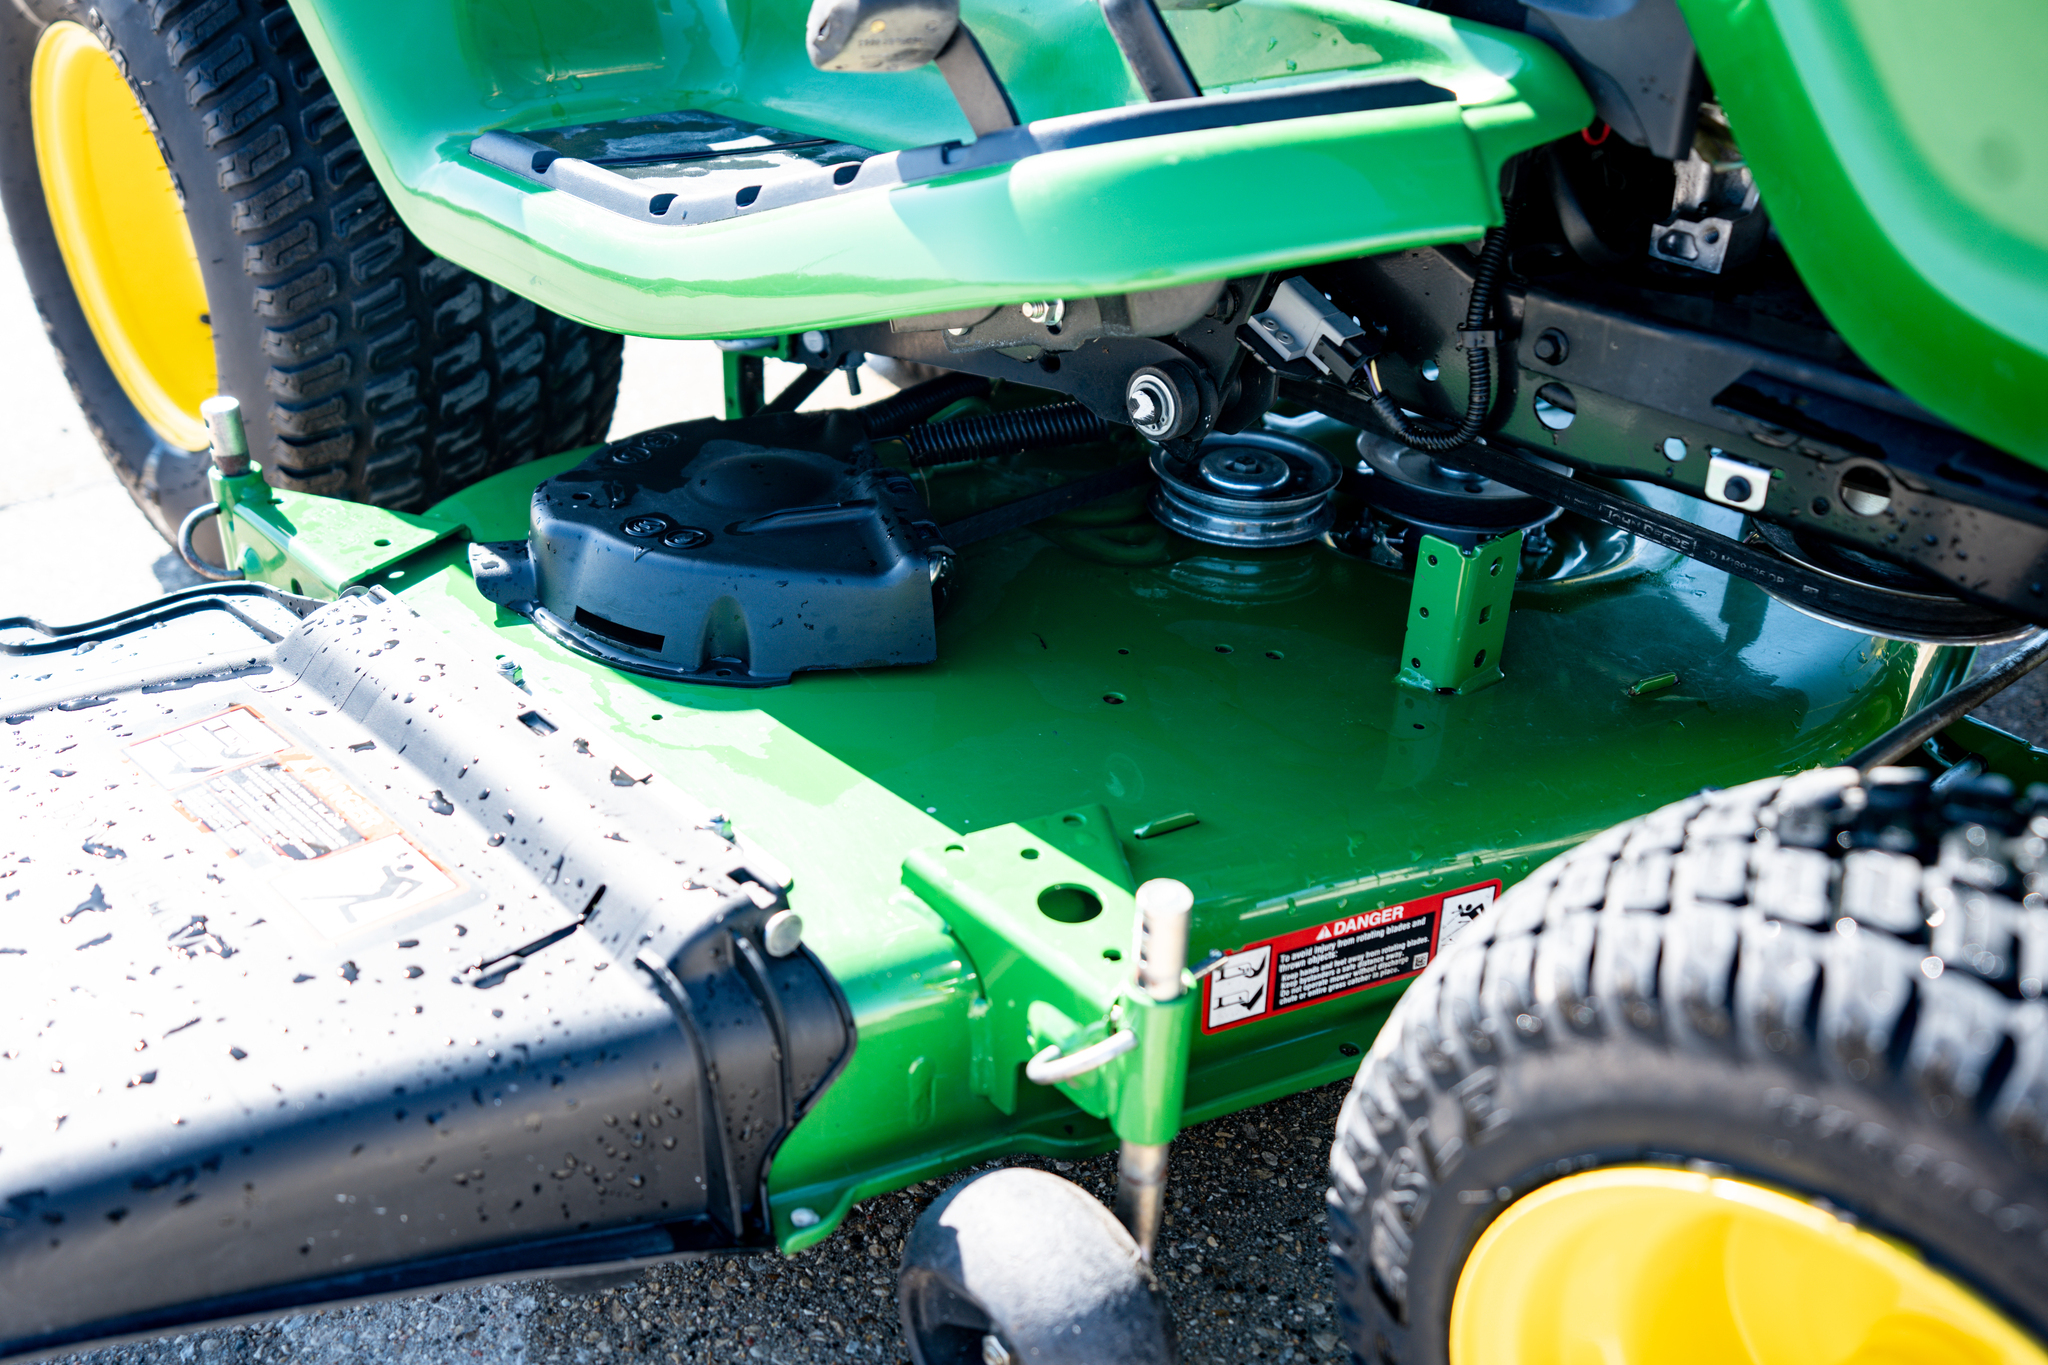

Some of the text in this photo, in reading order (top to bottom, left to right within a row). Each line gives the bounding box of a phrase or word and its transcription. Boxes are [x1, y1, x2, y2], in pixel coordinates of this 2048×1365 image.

[1643, 523, 1690, 551] DEERE
[298, 767, 389, 830] DANGER
[1280, 916, 1426, 963] To avoid injury from rotating blades and
[1333, 906, 1404, 936] DANGER
[1279, 949, 1338, 973] thrown objects:
[1280, 978, 1297, 990] Keep
[1299, 969, 1335, 985] bystanders
[1342, 963, 1356, 972] safe
[1357, 956, 1384, 968] distance
[1385, 949, 1404, 960] away.
[1280, 956, 1409, 997] Do not operate mower without discharge
[1281, 936, 1429, 982] Keep hands and feet away from rotating blades.
[1279, 995, 1298, 1005] chute
[1307, 986, 1327, 997] entire
[1328, 981, 1346, 992] grass
[1347, 974, 1371, 986] catcher
[1380, 967, 1399, 977] place.
